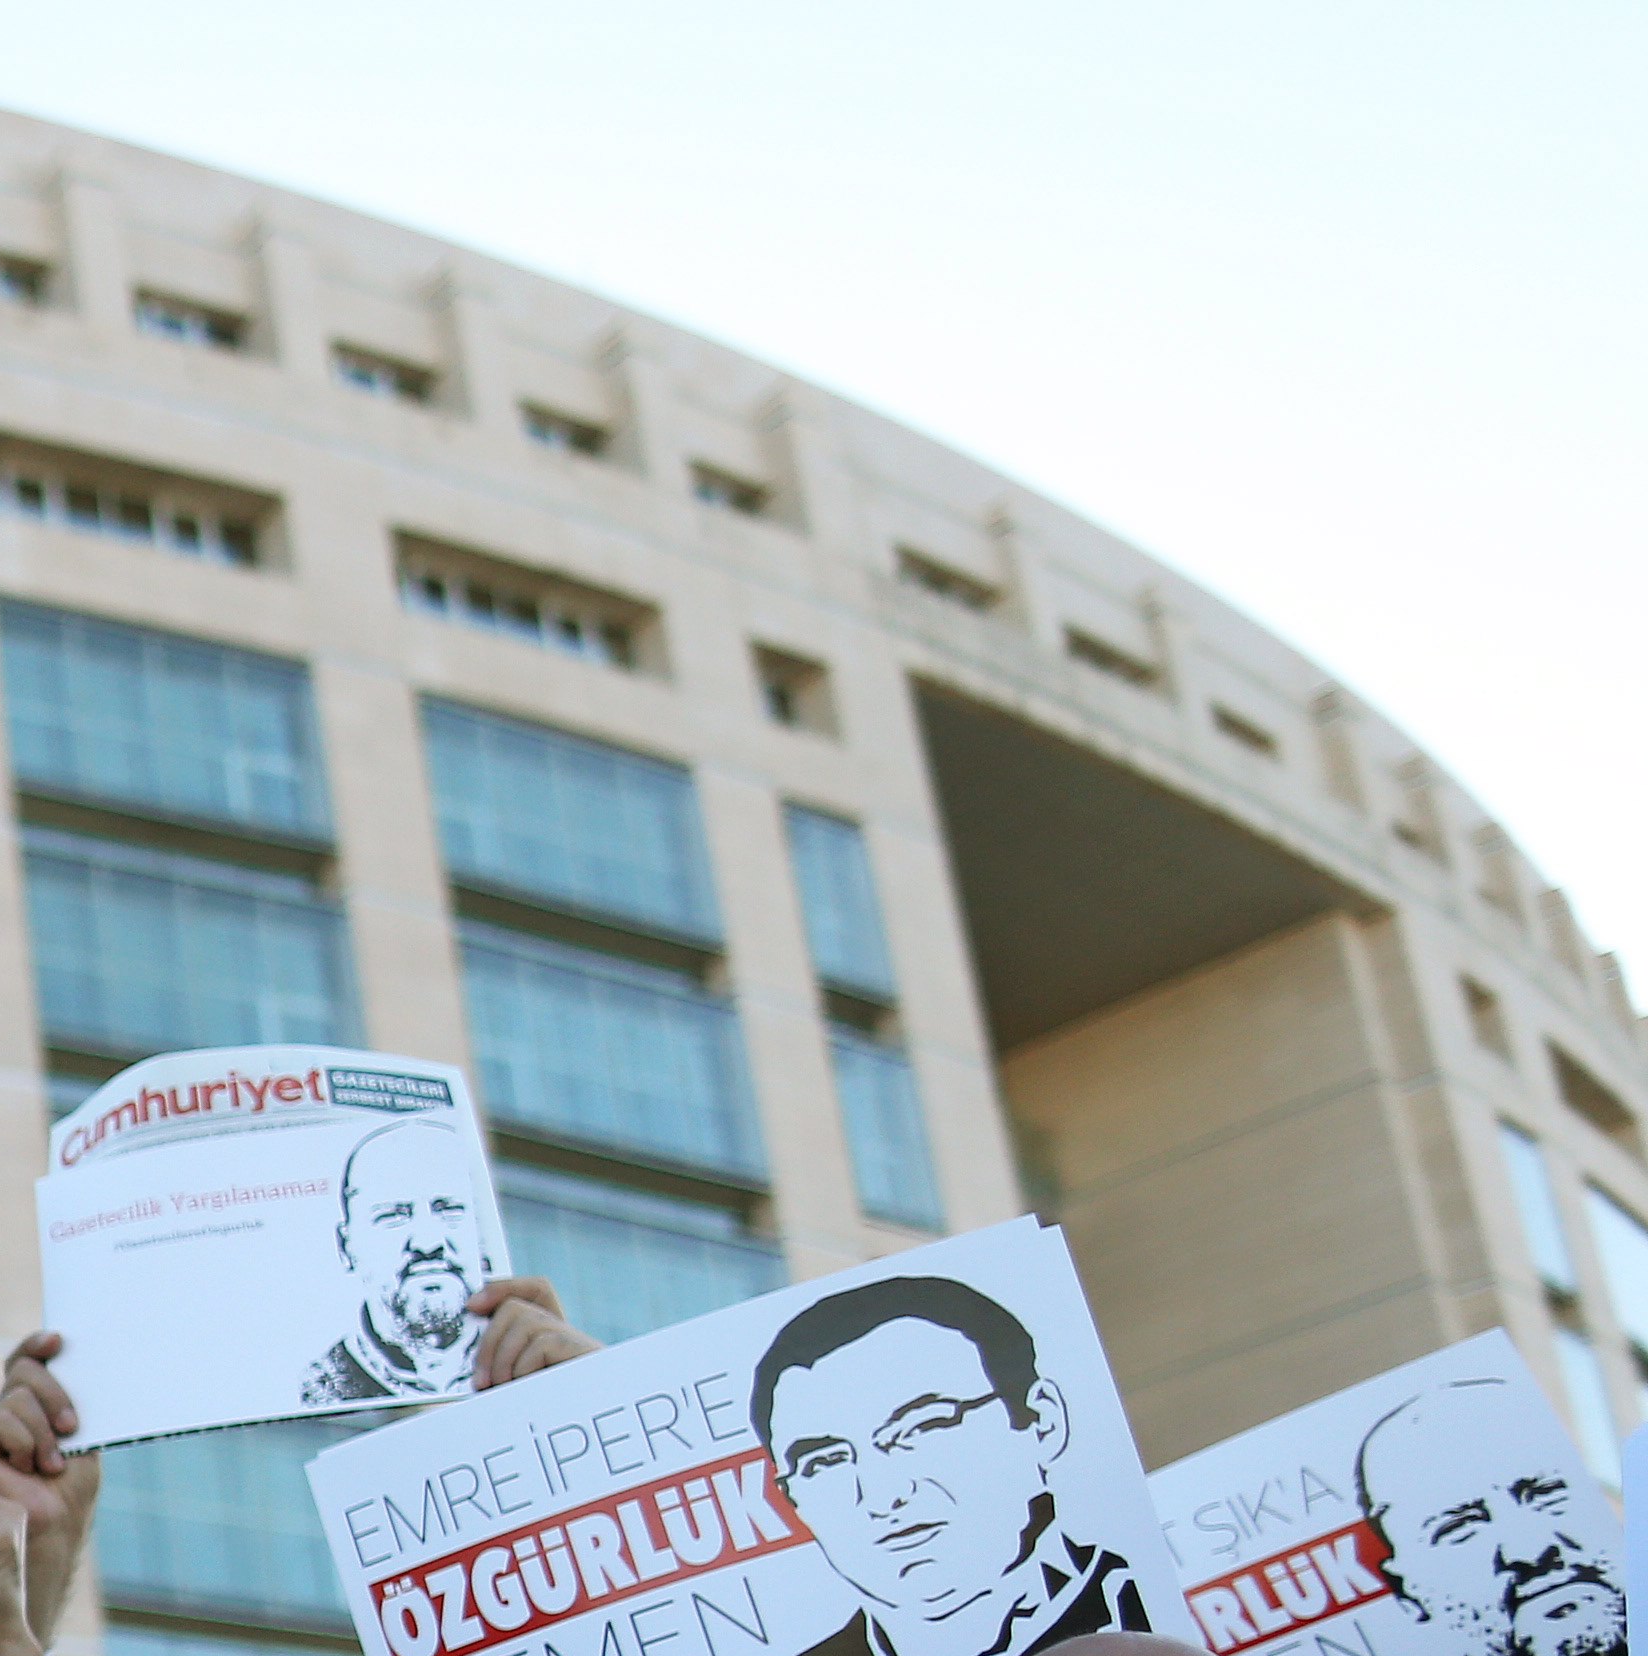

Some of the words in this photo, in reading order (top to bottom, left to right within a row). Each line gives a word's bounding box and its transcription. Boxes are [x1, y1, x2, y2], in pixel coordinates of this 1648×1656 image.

[59, 1068, 325, 1168] Cumhuriyet
[344, 1448, 522, 1569] EMRE
[530, 1373, 750, 1495] İPER'E
[1192, 1466, 1345, 1566] ŞIK'A
